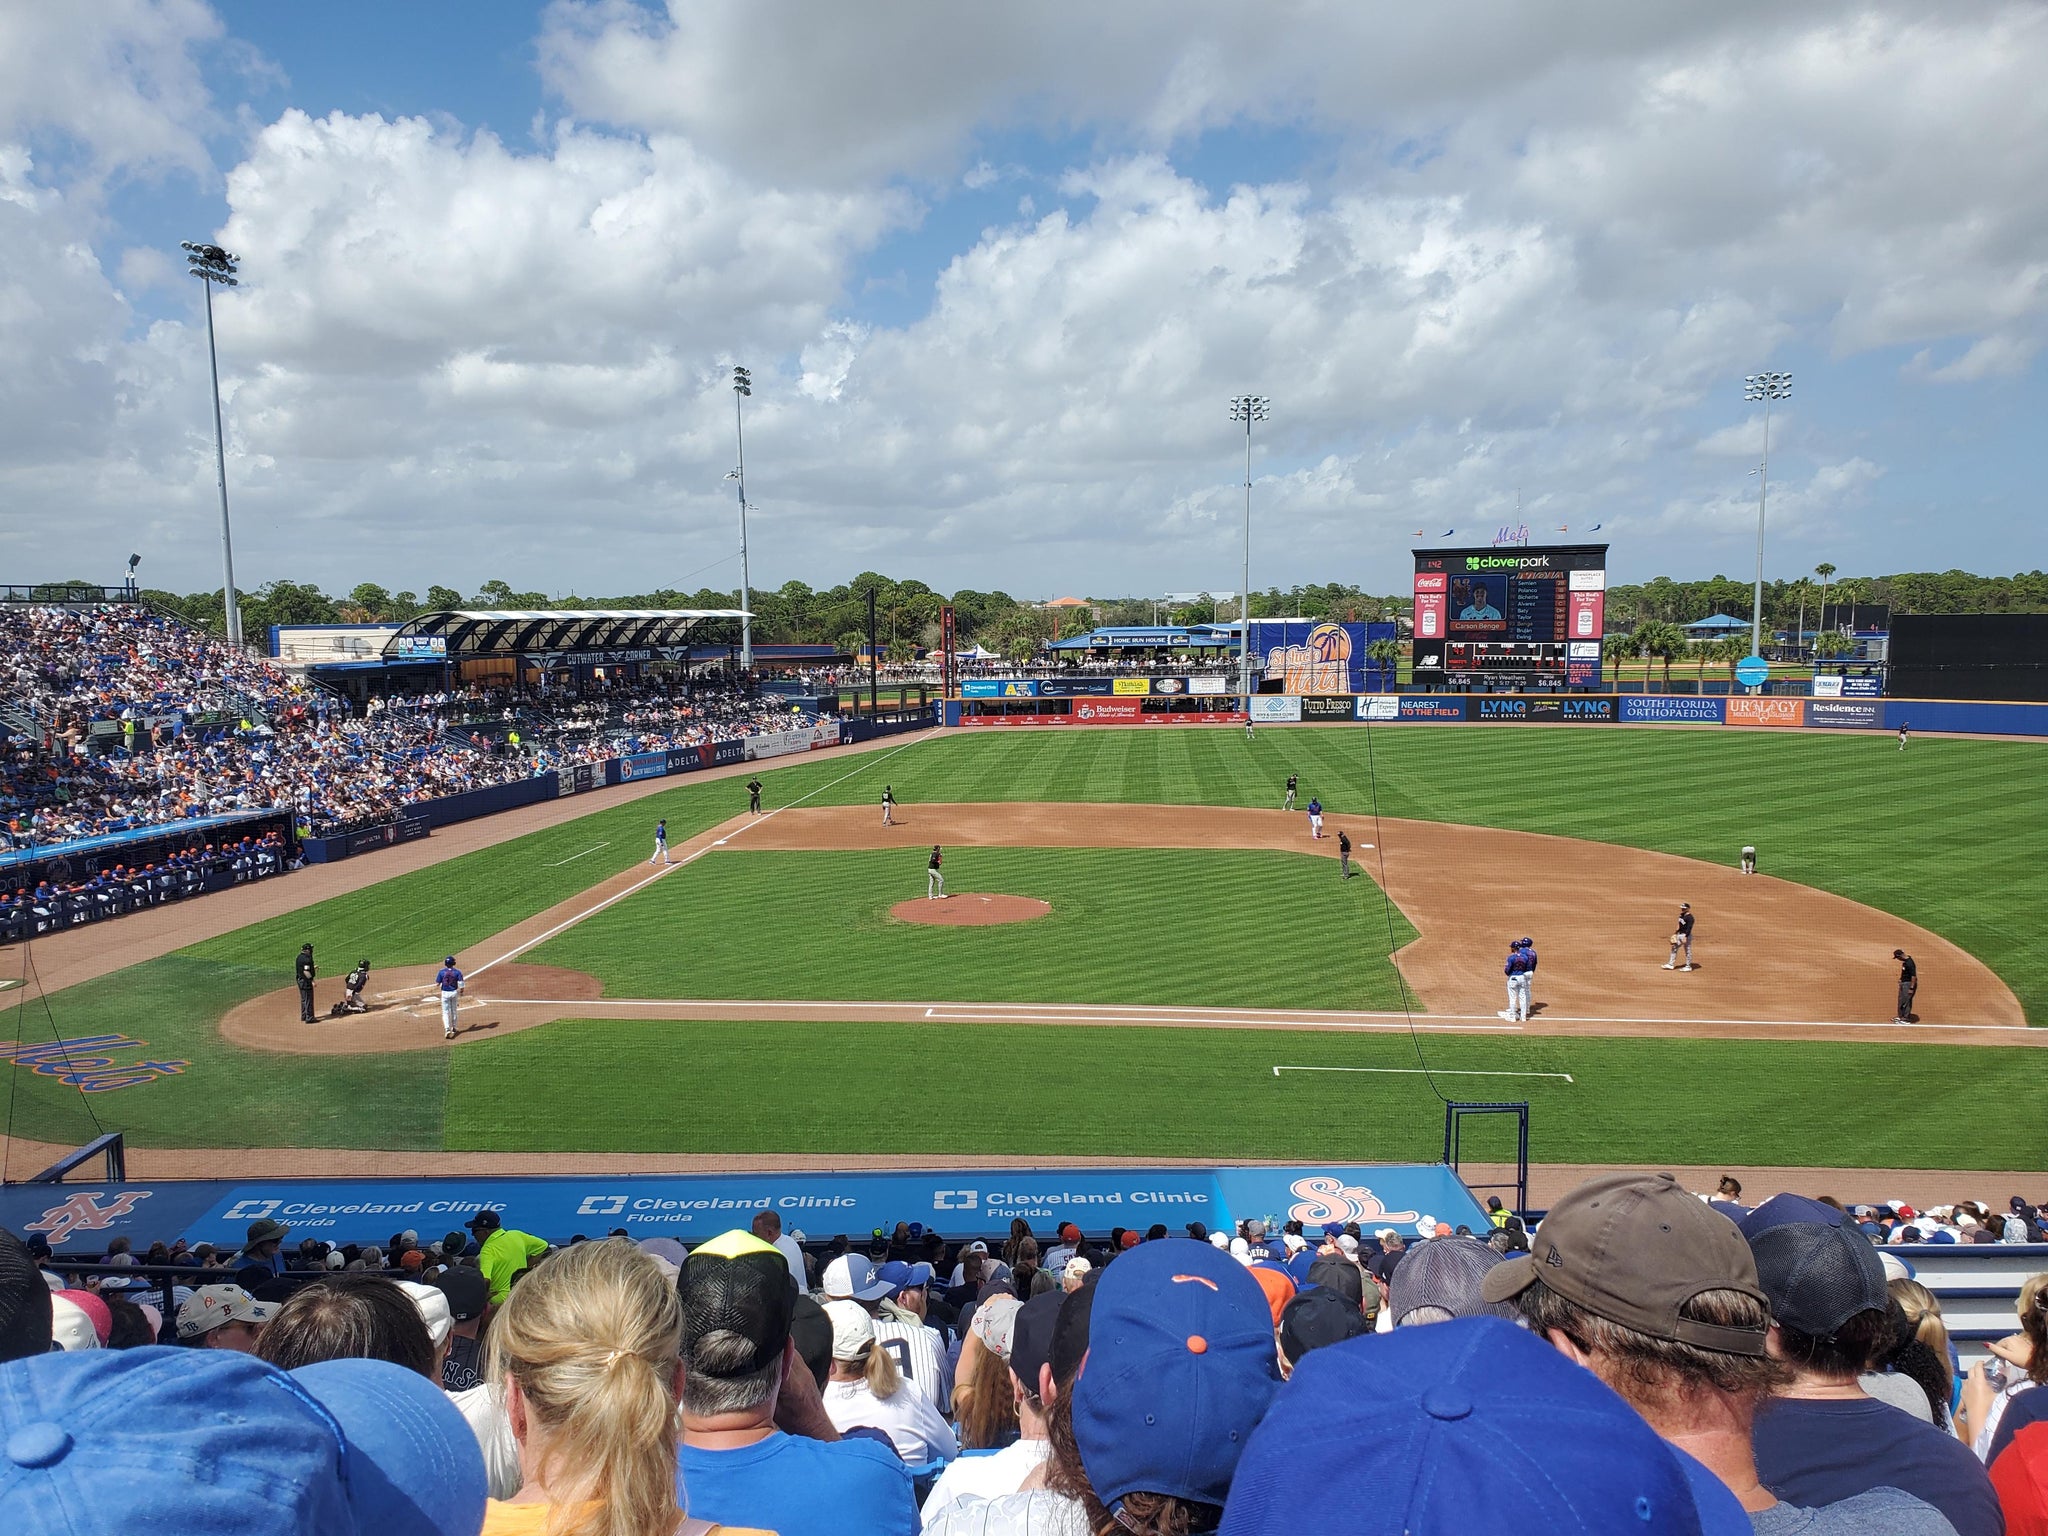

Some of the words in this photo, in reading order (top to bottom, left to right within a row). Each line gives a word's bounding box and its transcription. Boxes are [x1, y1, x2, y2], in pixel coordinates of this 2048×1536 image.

[1492, 524, 1529, 544] Mets
[1480, 554, 1550, 569] cloverpark
[1418, 578, 1442, 588] Coca-Cola
[567, 652, 604, 664] CUTWATER
[625, 650, 651, 661] CORNER
[1285, 664, 1338, 694] Mets
[1303, 698, 1325, 709] TUTTO
[1326, 699, 1351, 710] FRESCO
[1627, 699, 1665, 708] SOUTH
[1670, 700, 1717, 709] FLORIDA
[1730, 700, 1798, 712] UROLOGY
[1813, 704, 1862, 712] Residence
[1627, 708, 1717, 718] ORTHOPAEDICS
[723, 747, 745, 758] DELTA
[675, 755, 699, 766] DELTA
[0, 1034, 192, 1092] Mets
[633, 1197, 770, 1209] Cleveland
[779, 1196, 857, 1208] Clinic
[986, 1192, 1122, 1204] Cleveland
[1130, 1192, 1208, 1203] Clinic
[282, 1202, 424, 1214] Cleveland
[428, 1200, 507, 1212] Clinic
[988, 1208, 1053, 1217] Florida
[273, 1218, 336, 1227] Florida
[626, 1214, 693, 1222] Florida
[1250, 1248, 1269, 1258] ETER
[184, 1321, 199, 1332] TB
